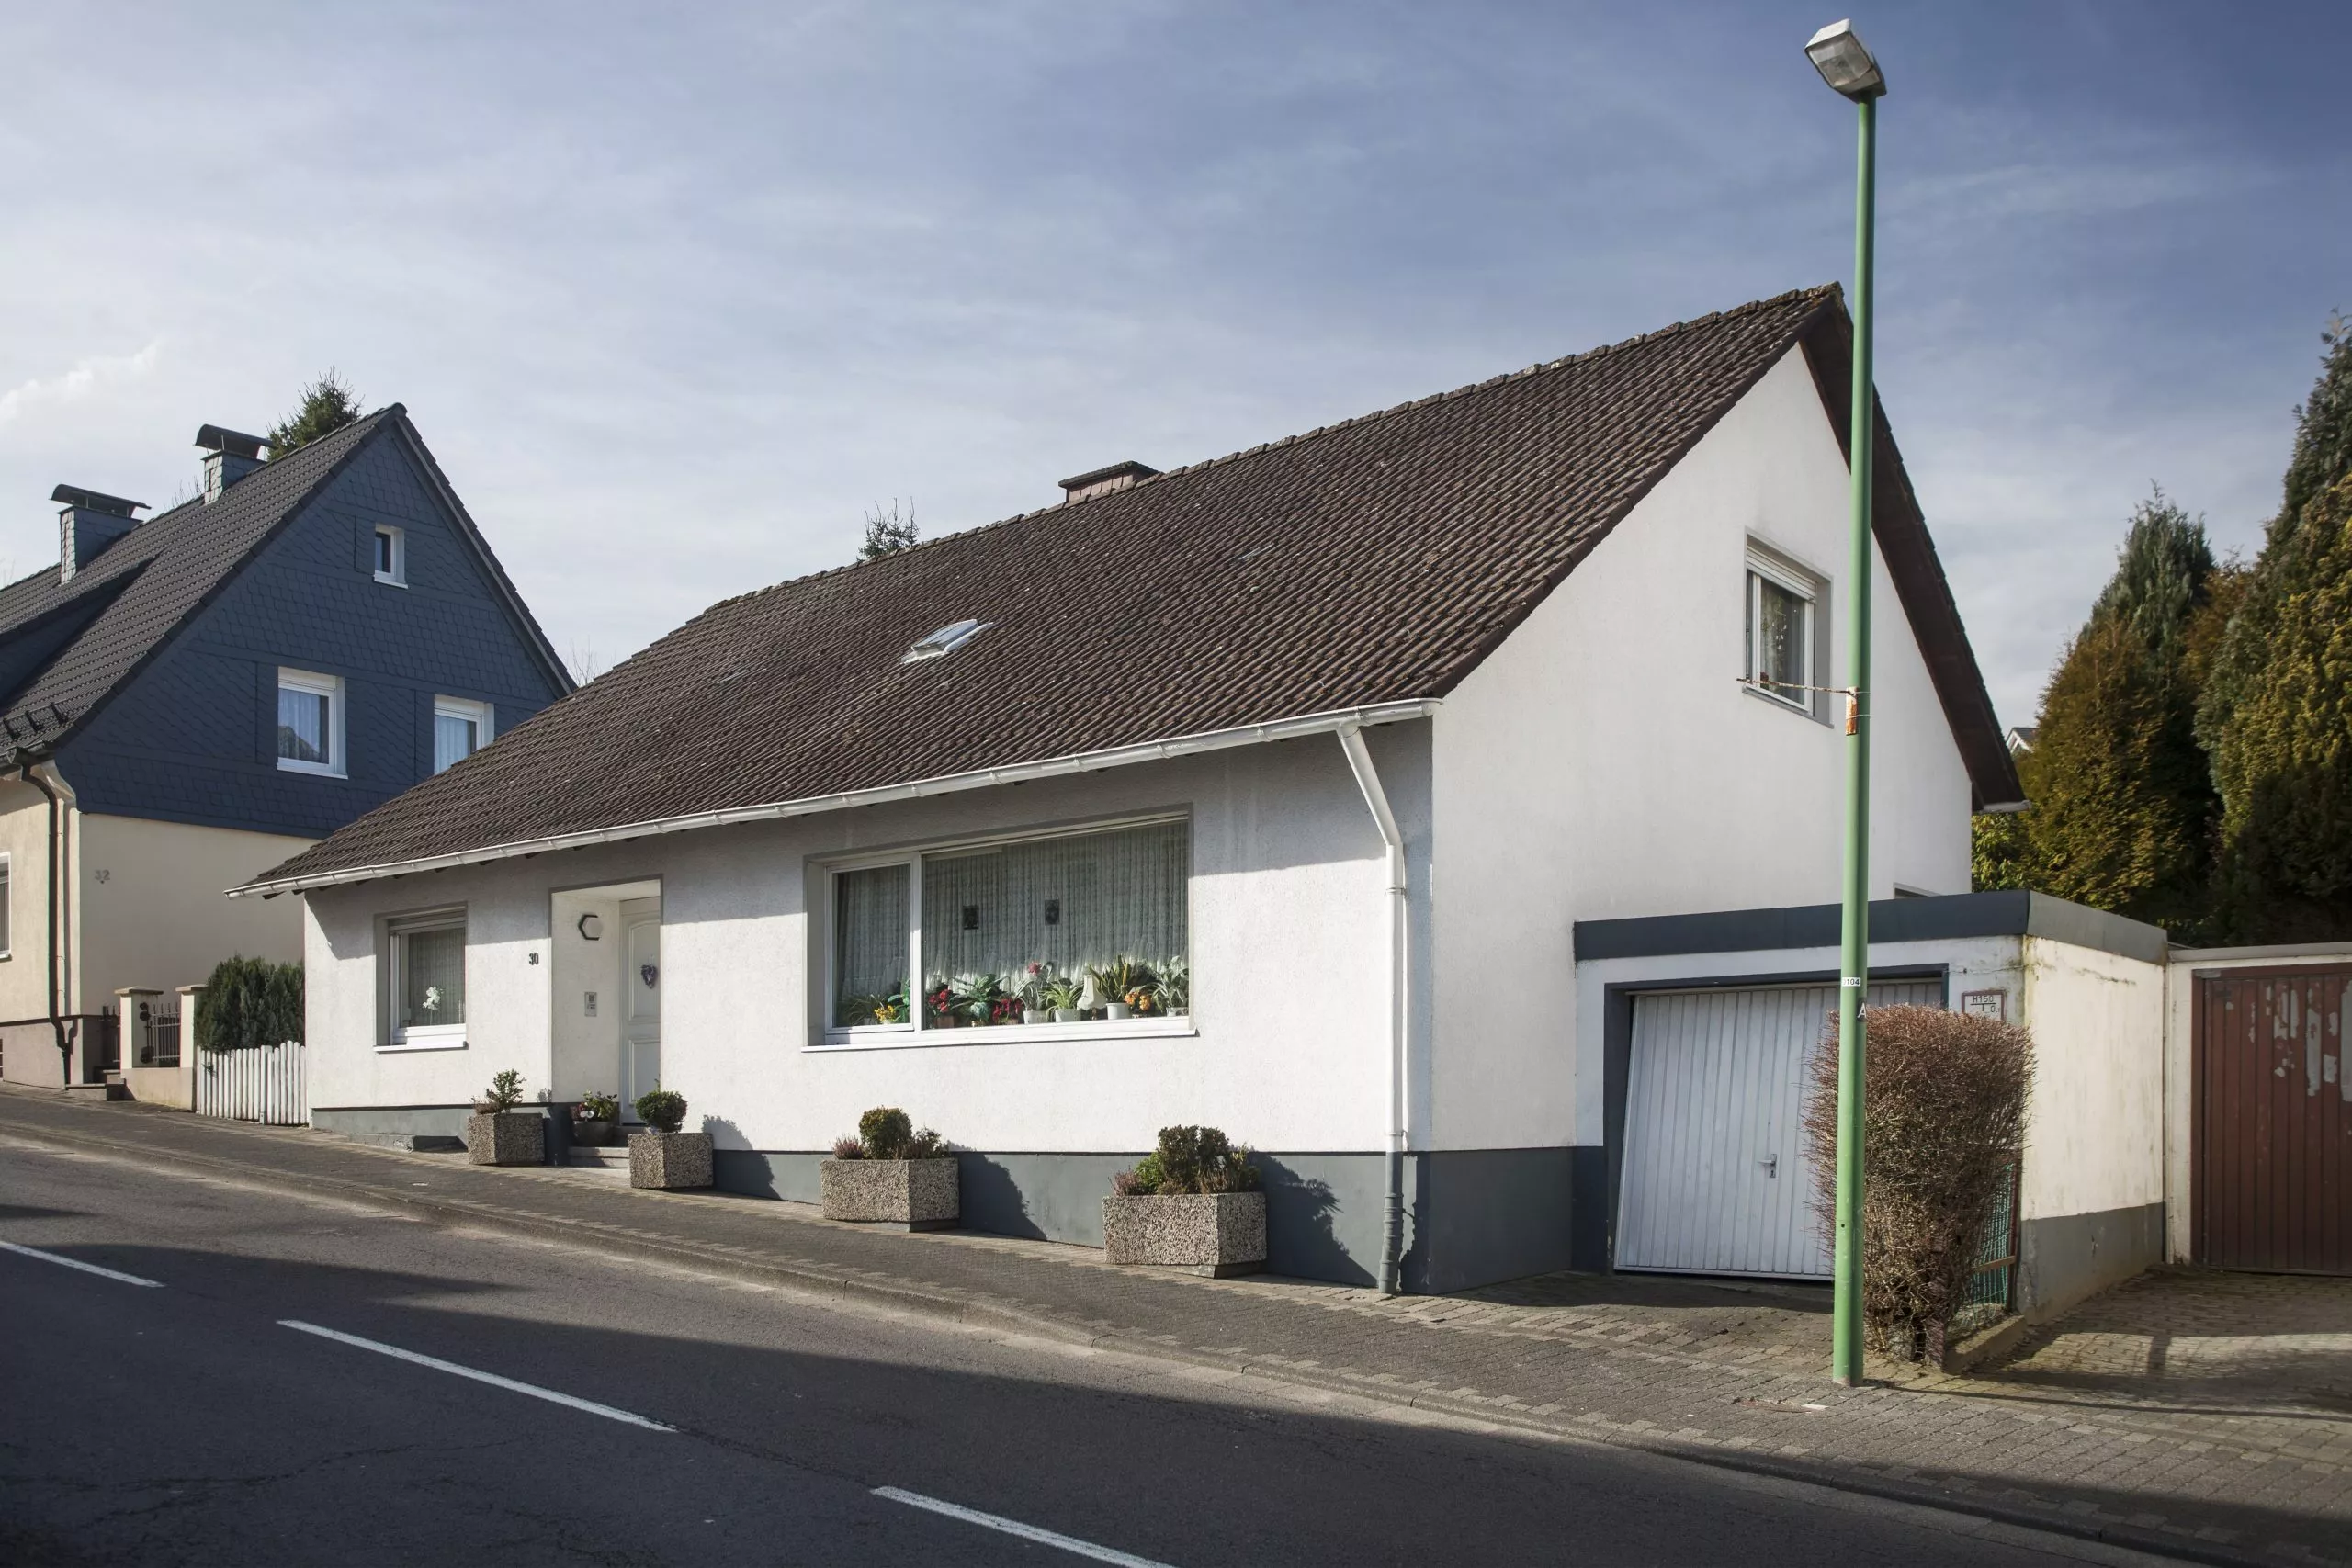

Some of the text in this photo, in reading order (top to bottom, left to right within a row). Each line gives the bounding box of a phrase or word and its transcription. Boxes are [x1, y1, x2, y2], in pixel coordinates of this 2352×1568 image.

[95, 869, 110, 881] 32
[528, 952, 539, 965] 30
[1973, 995, 1994, 1003] H150
[1857, 1002, 1867, 1019] A
